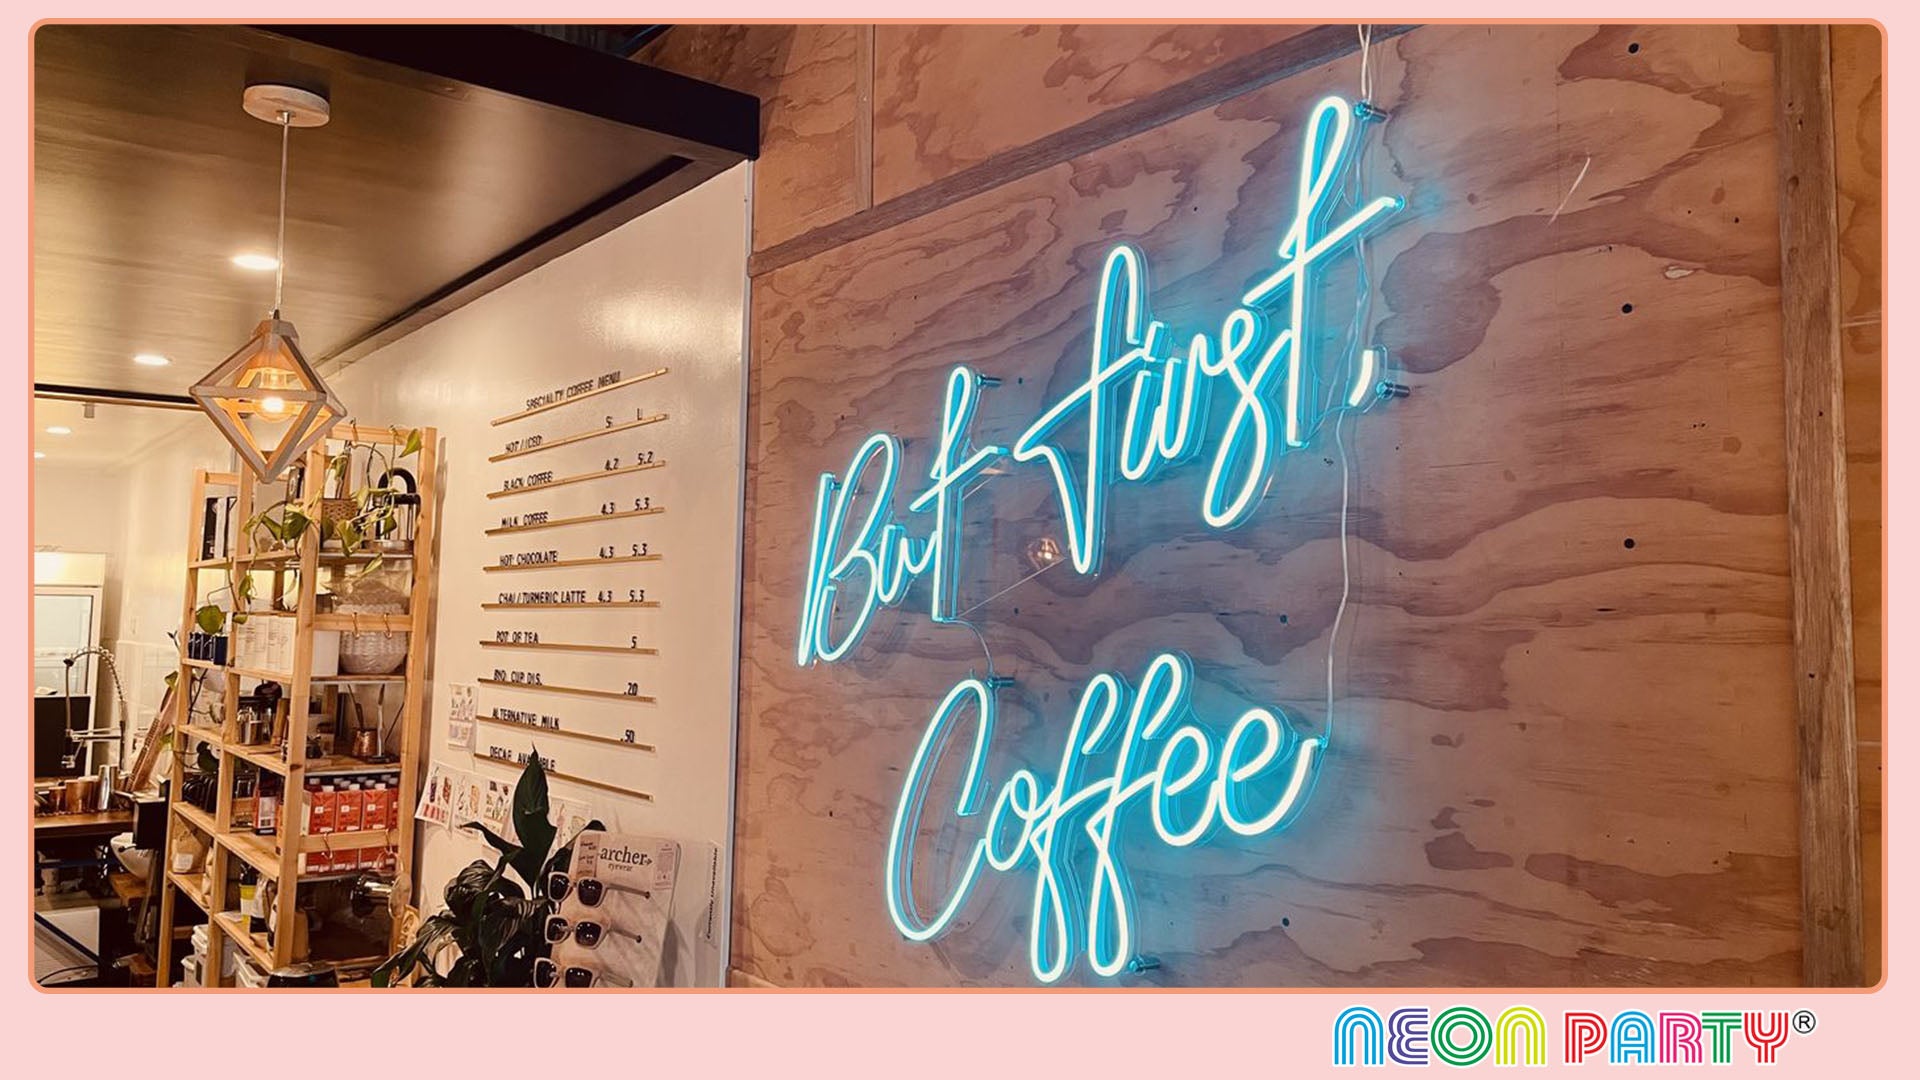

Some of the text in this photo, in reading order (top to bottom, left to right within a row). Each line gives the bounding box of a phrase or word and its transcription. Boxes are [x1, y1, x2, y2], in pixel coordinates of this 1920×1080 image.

[566, 379, 594, 399] COFFEE
[597, 370, 621, 389] MENU
[527, 471, 553, 487] COFFEE
[501, 497, 650, 528] MILK COFFEE 4.3 5.3
[800, 365, 1004, 666] But
[516, 550, 558, 566] CHOCOLATE
[599, 546, 614, 559] 4.3
[632, 543, 648, 557] 5.3
[561, 590, 587, 604] LATTE
[598, 590, 613, 603] 4.3
[629, 589, 645, 603] 5.3
[496, 630, 509, 644] POT
[512, 631, 523, 644] OF
[524, 631, 539, 645] TEA
[492, 708, 537, 727] ALTERNATIVE
[541, 715, 560, 731] MILK
[490, 746, 512, 762] DECAF
[886, 652, 1326, 984] Coffee
[600, 845, 648, 866] archer
[608, 862, 633, 872] eyewear
